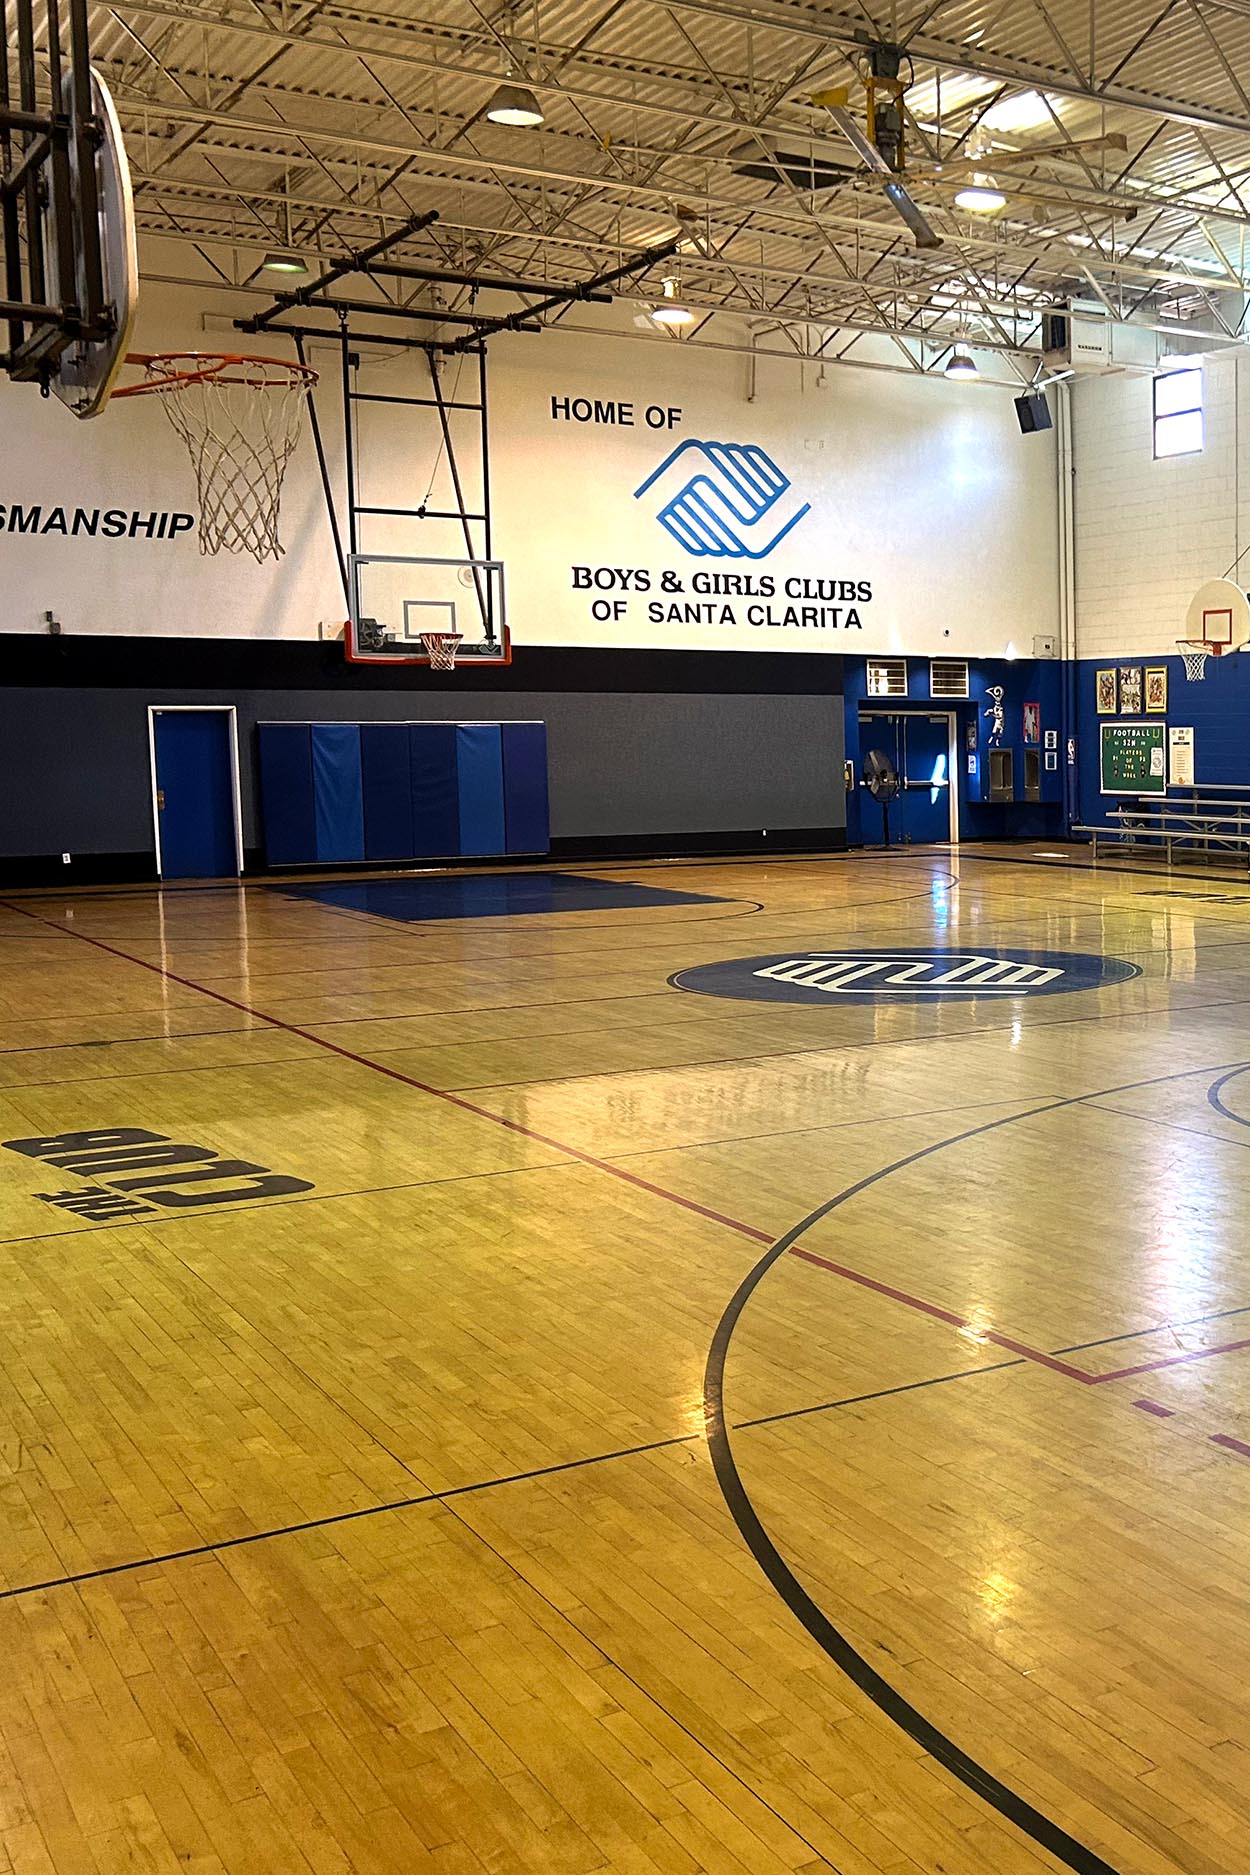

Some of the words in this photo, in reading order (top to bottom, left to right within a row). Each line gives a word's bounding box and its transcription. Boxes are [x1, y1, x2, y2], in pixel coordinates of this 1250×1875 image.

[551, 396, 634, 426] HOME
[645, 405, 682, 430] OF
[0, 503, 195, 540] MANSHIP
[572, 566, 651, 592] BOYS
[660, 570, 683, 593] &
[692, 572, 775, 598] GIRLS
[784, 577, 873, 602] CLUBS
[592, 600, 627, 621] OF
[648, 602, 736, 625] SANTA
[747, 605, 862, 629] CLARITA
[1, 1127, 316, 1207] CLUB
[31, 1186, 158, 1222] THE
